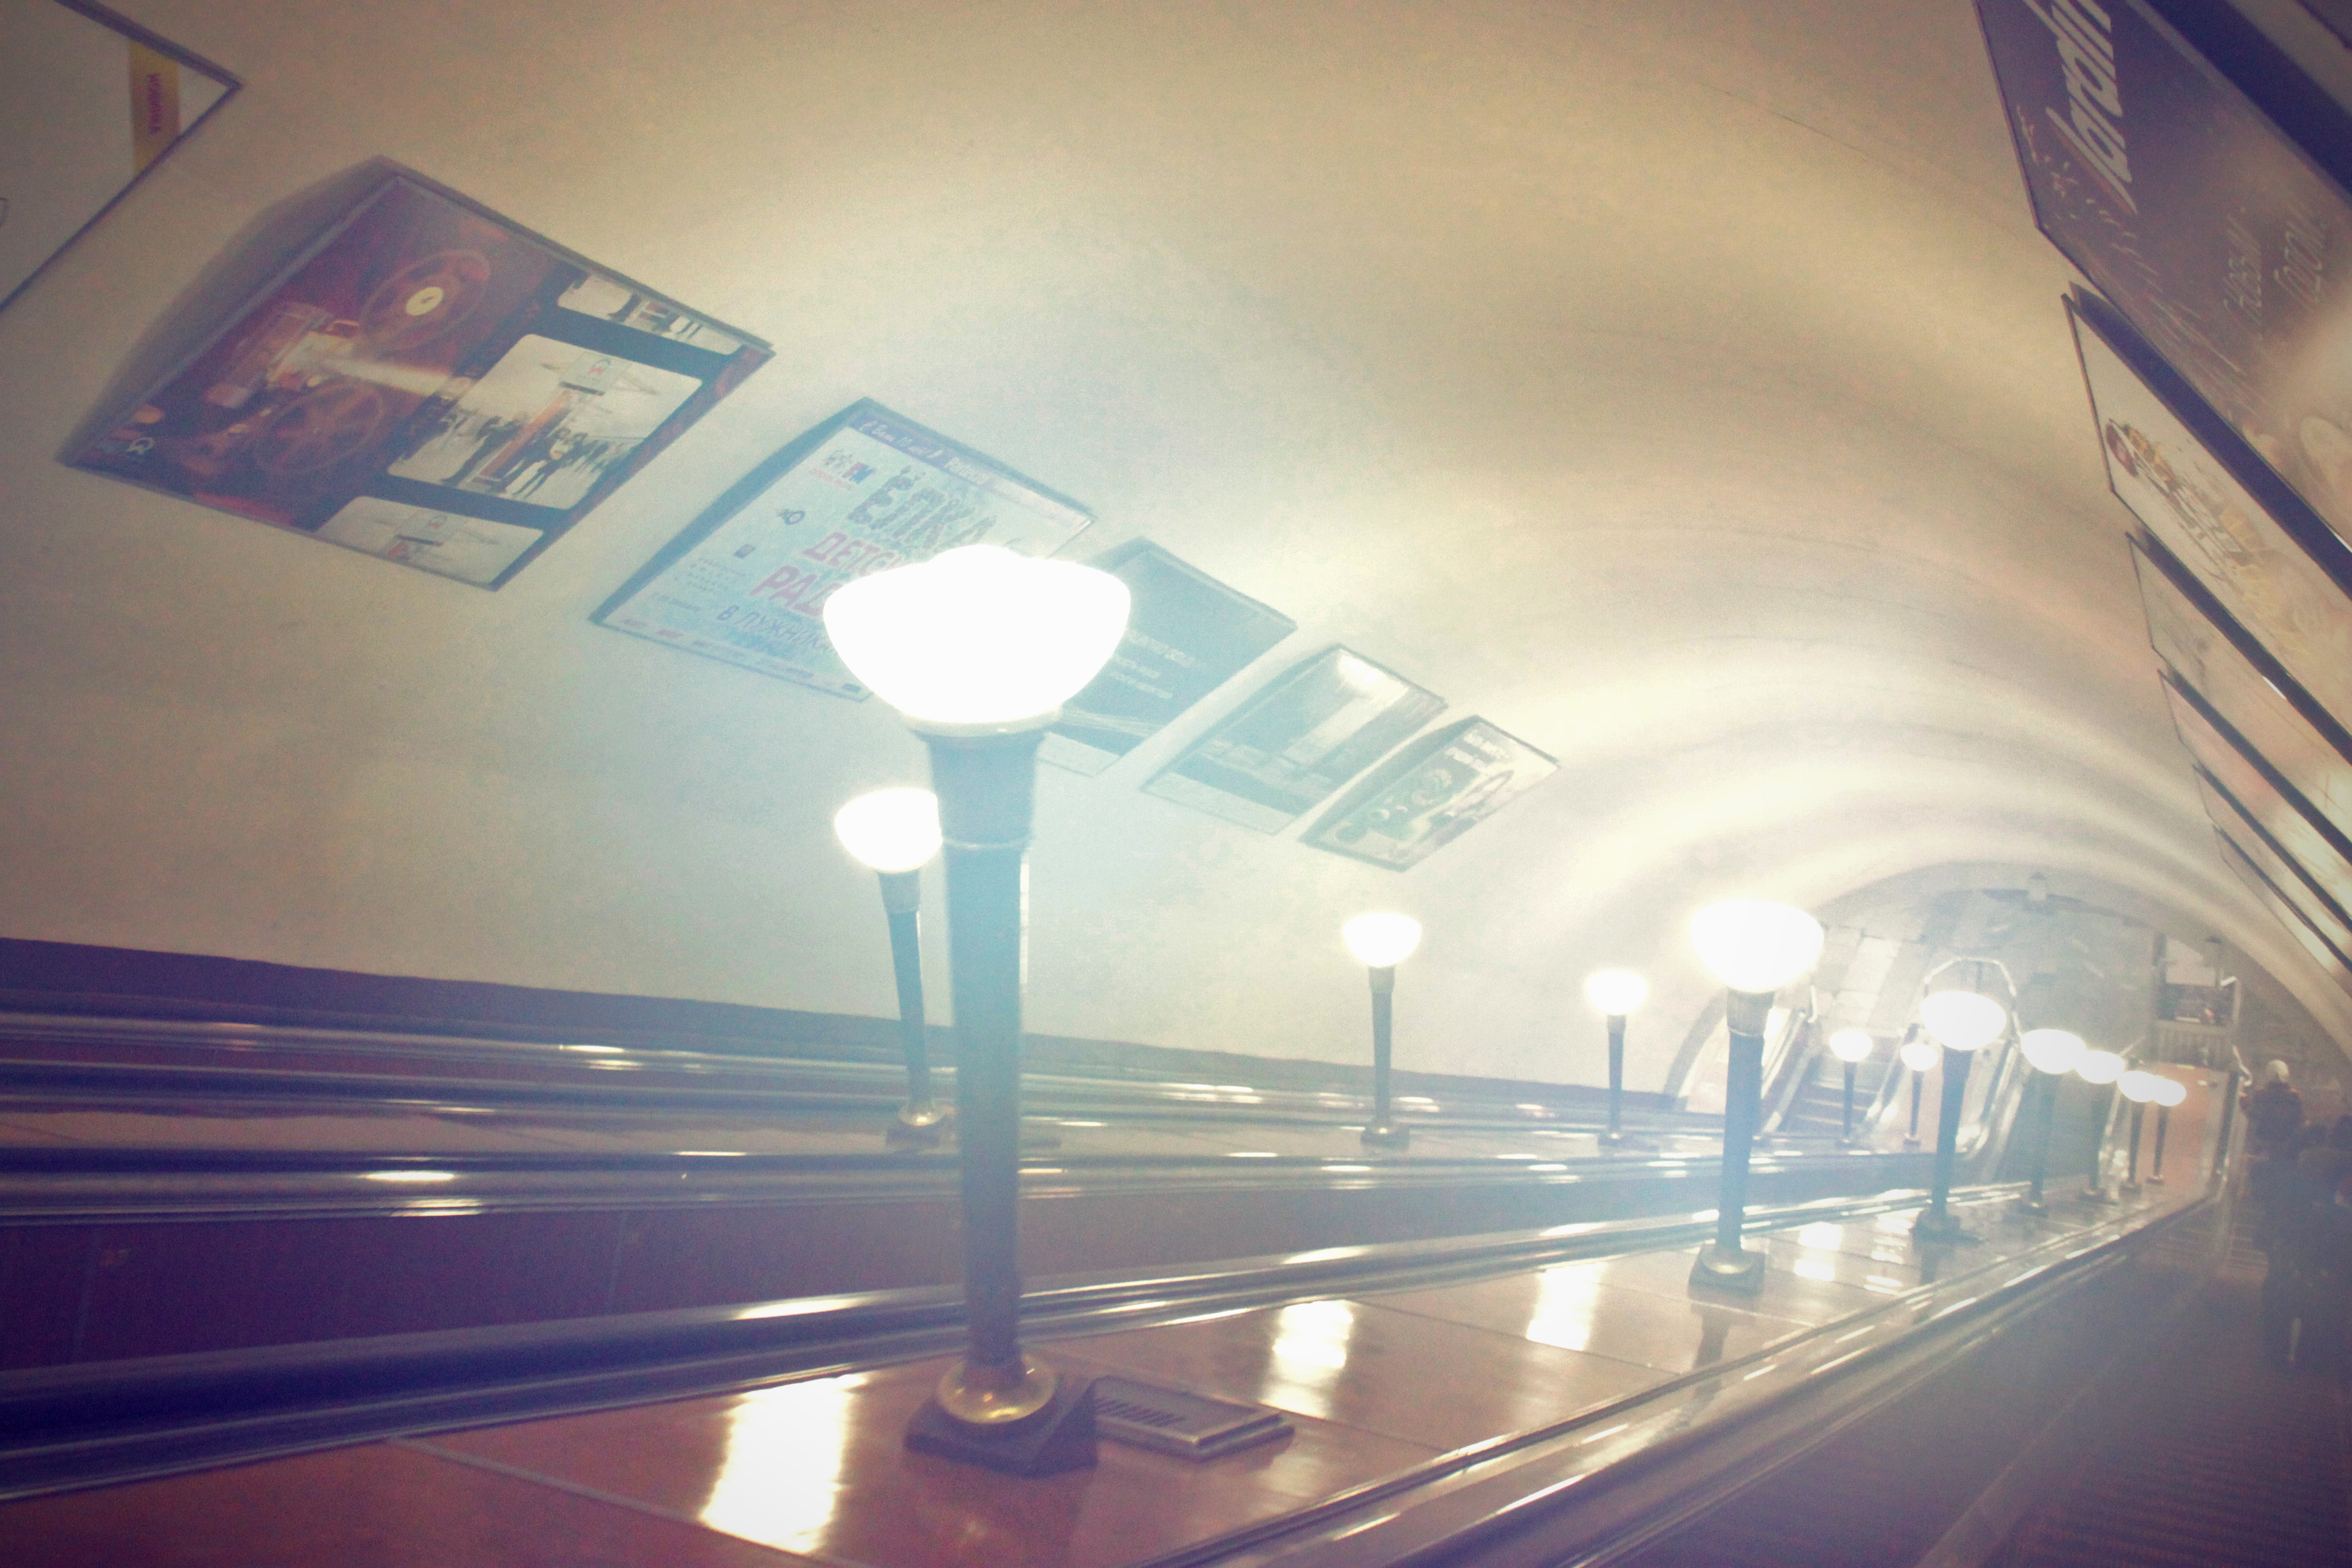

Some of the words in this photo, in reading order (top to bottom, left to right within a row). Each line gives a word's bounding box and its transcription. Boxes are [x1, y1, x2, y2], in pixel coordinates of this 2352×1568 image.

[800, 531, 903, 576] ДЕТС
[749, 564, 841, 617] РАД
[734, 613, 832, 650] ЛУЖНИКА
